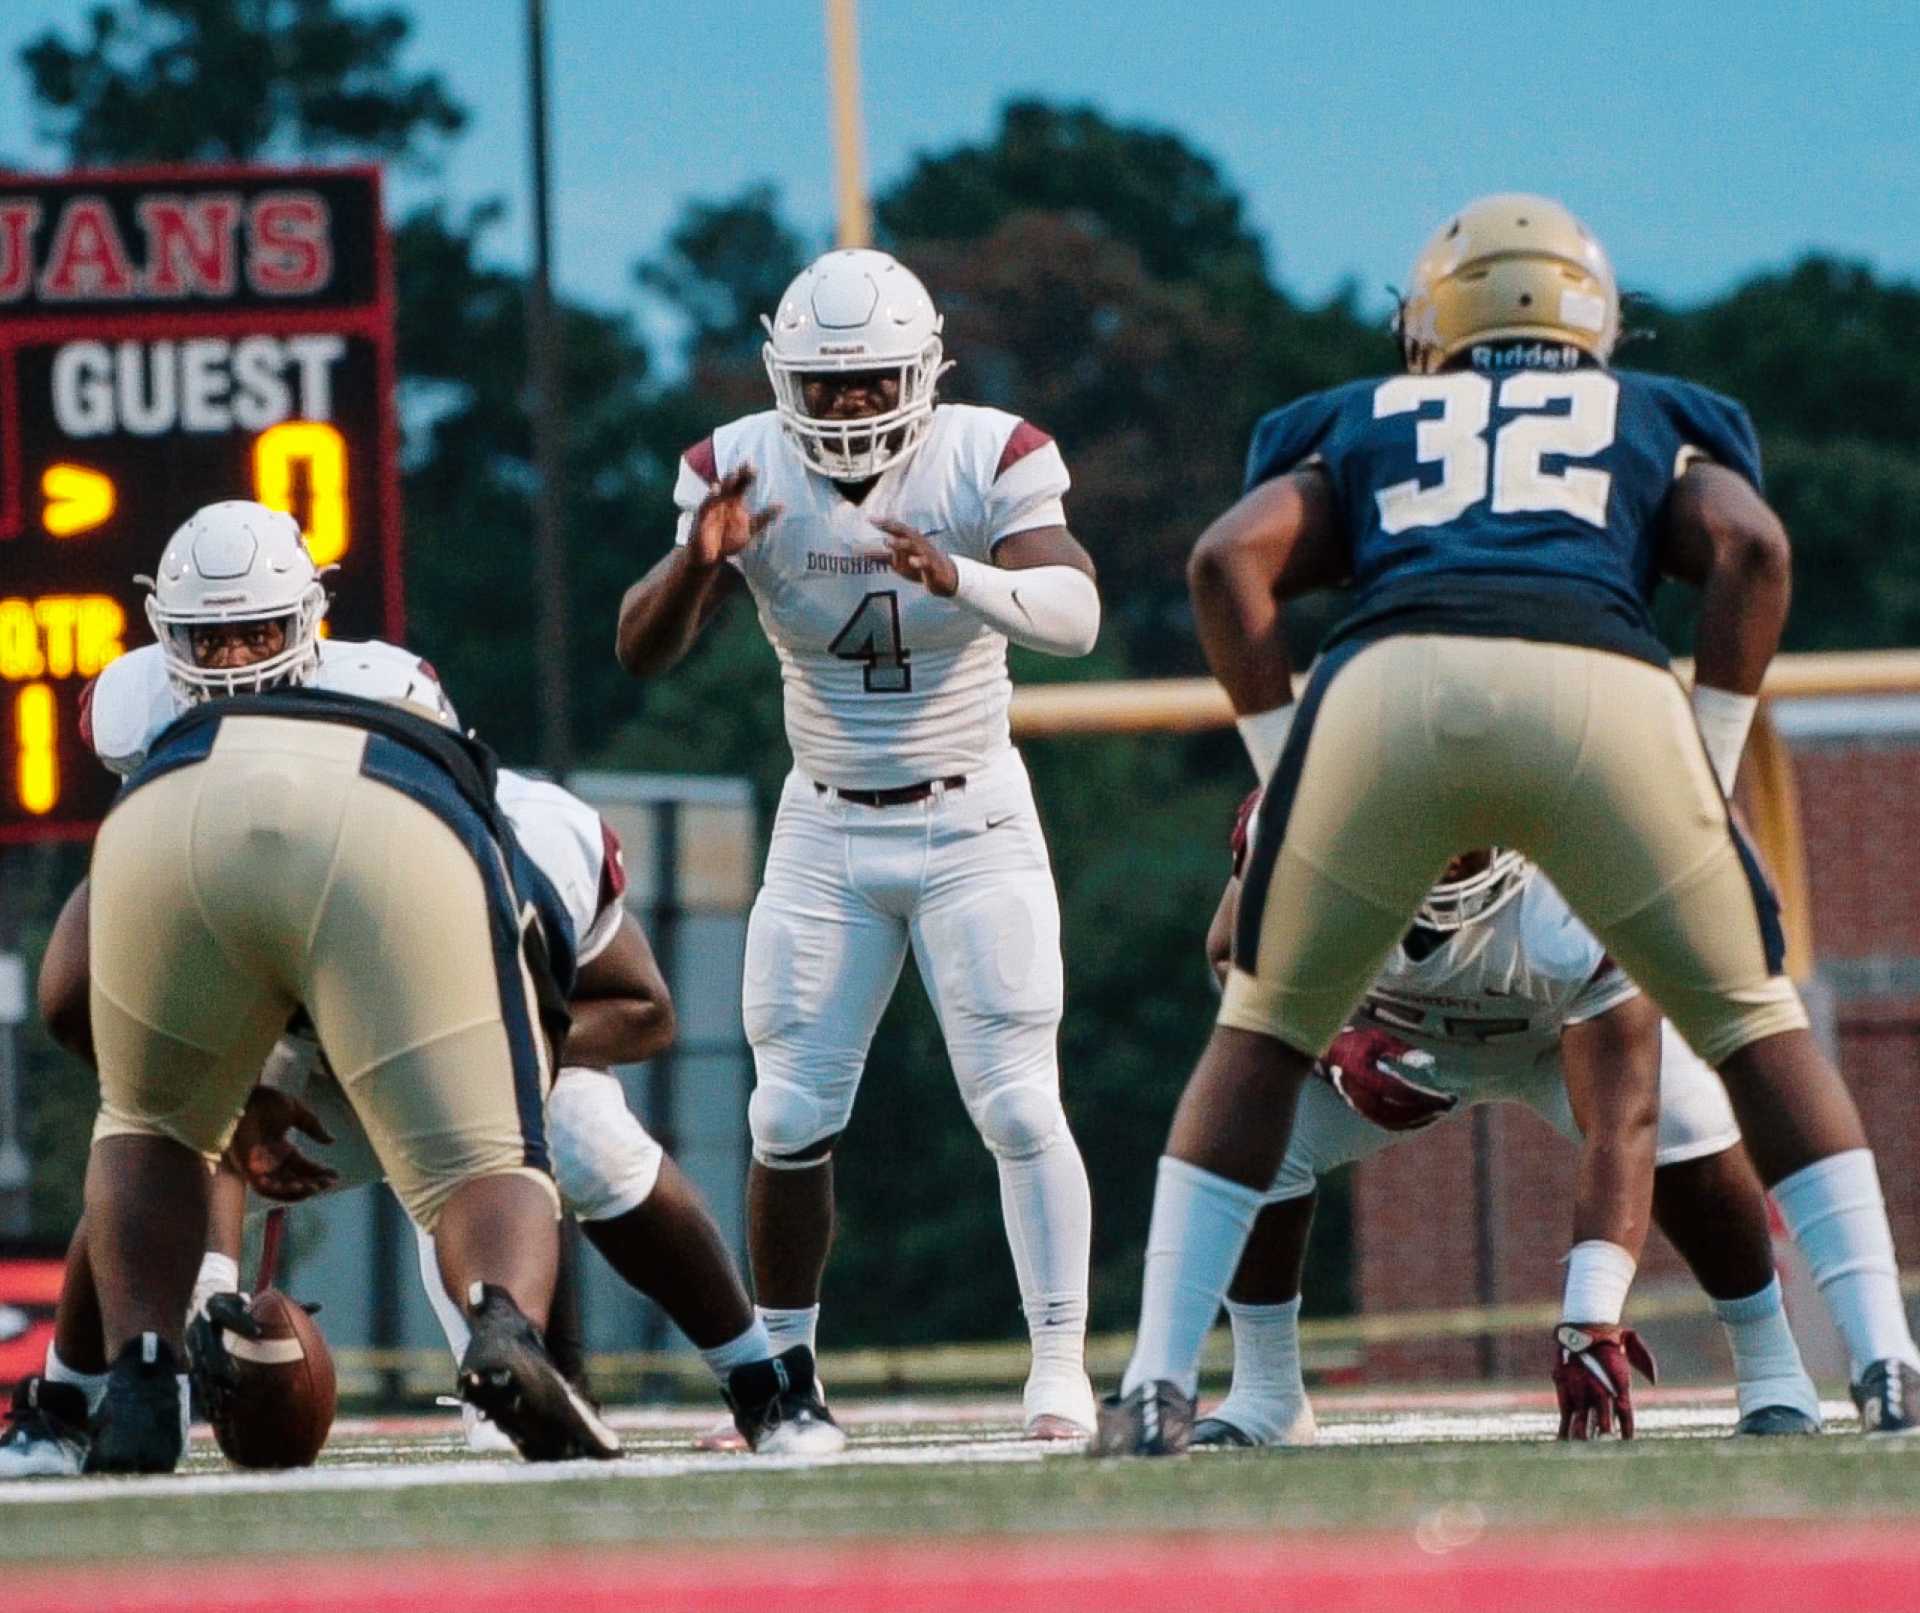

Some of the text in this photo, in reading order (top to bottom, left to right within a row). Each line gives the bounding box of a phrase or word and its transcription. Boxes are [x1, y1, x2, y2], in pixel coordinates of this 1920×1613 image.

[52, 334, 346, 437] GUEST
[1373, 371, 1619, 535] 32
[0, 595, 126, 681] QTR
[828, 590, 911, 692] 4
[18, 684, 58, 815] 1
